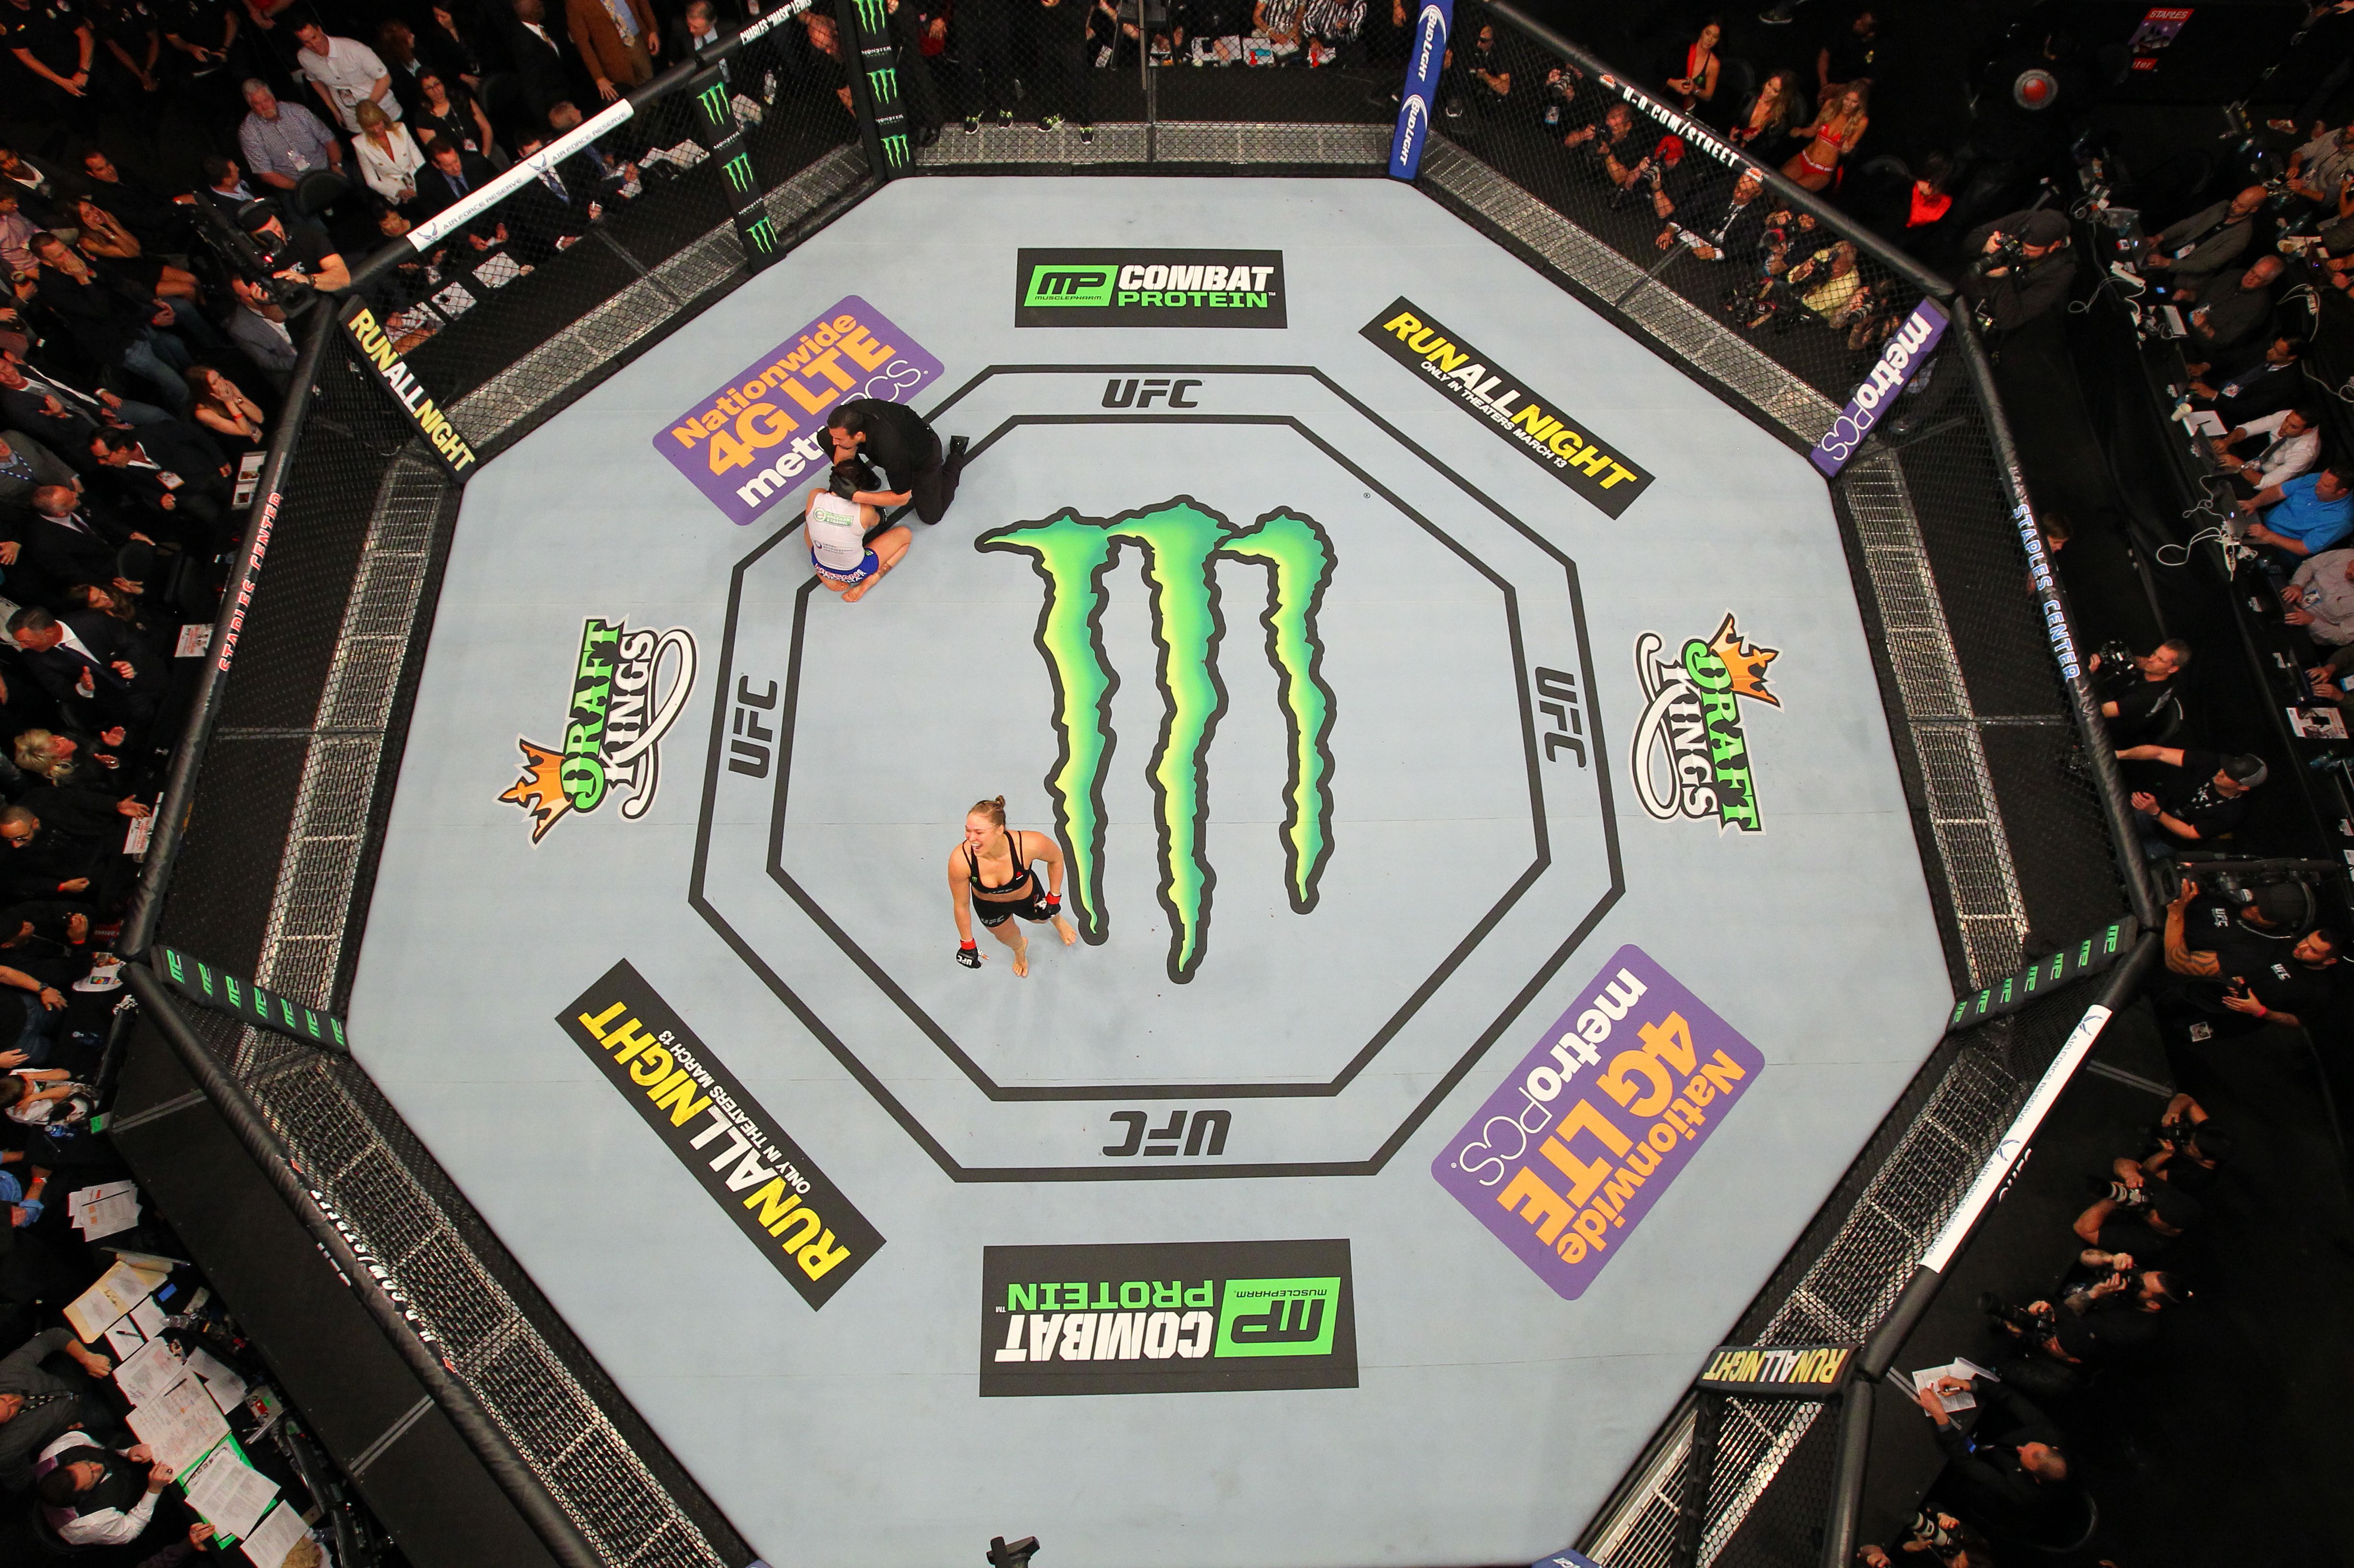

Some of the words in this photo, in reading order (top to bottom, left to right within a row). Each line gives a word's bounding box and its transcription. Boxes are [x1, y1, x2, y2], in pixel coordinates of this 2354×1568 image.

[2149, 10, 2188, 19] STAPLES
[552, 149, 566, 162] AIR
[566, 133, 592, 153] FORCE
[592, 111, 627, 138] RESERVE
[443, 216, 458, 230] AIR
[458, 200, 485, 221] FORCE
[485, 177, 523, 206] RESERVE
[1118, 265, 1274, 292] COMBAT
[1118, 291, 1268, 308] PROTEIN
[671, 314, 856, 448] Nationwide
[709, 402, 800, 475] 4G
[779, 325, 896, 415] LTE
[1102, 379, 1202, 408] UFC
[1421, 361, 1450, 383] ONLY
[1447, 380, 1463, 392] IN
[1461, 388, 1515, 431] THEATERS
[1513, 428, 1555, 459] MARCH
[1553, 456, 1568, 469] 13
[2013, 503, 2053, 591] STAPLES
[2043, 599, 2080, 683] CENTER
[728, 675, 777, 779] UFC
[1535, 666, 1587, 768] UFC
[980, 915, 1005, 925] UFC
[957, 955, 973, 966] UFC
[658, 1030, 676, 1046] 13
[670, 1042, 715, 1089] MARCH
[1596, 1010, 1697, 1117] 4G
[709, 1085, 768, 1149] THEATERS
[1102, 1110, 1232, 1157] UFC
[764, 1145, 783, 1163] IN
[776, 1161, 811, 1195] ONLY
[1496, 1099, 1634, 1246] LTE
[1557, 1049, 1747, 1264] Nationwide
[1008, 1280, 1214, 1311] PROTEIN
[1236, 1289, 1327, 1298] MUSCLEPHARM
[994, 1311, 1214, 1362] COMBAT
